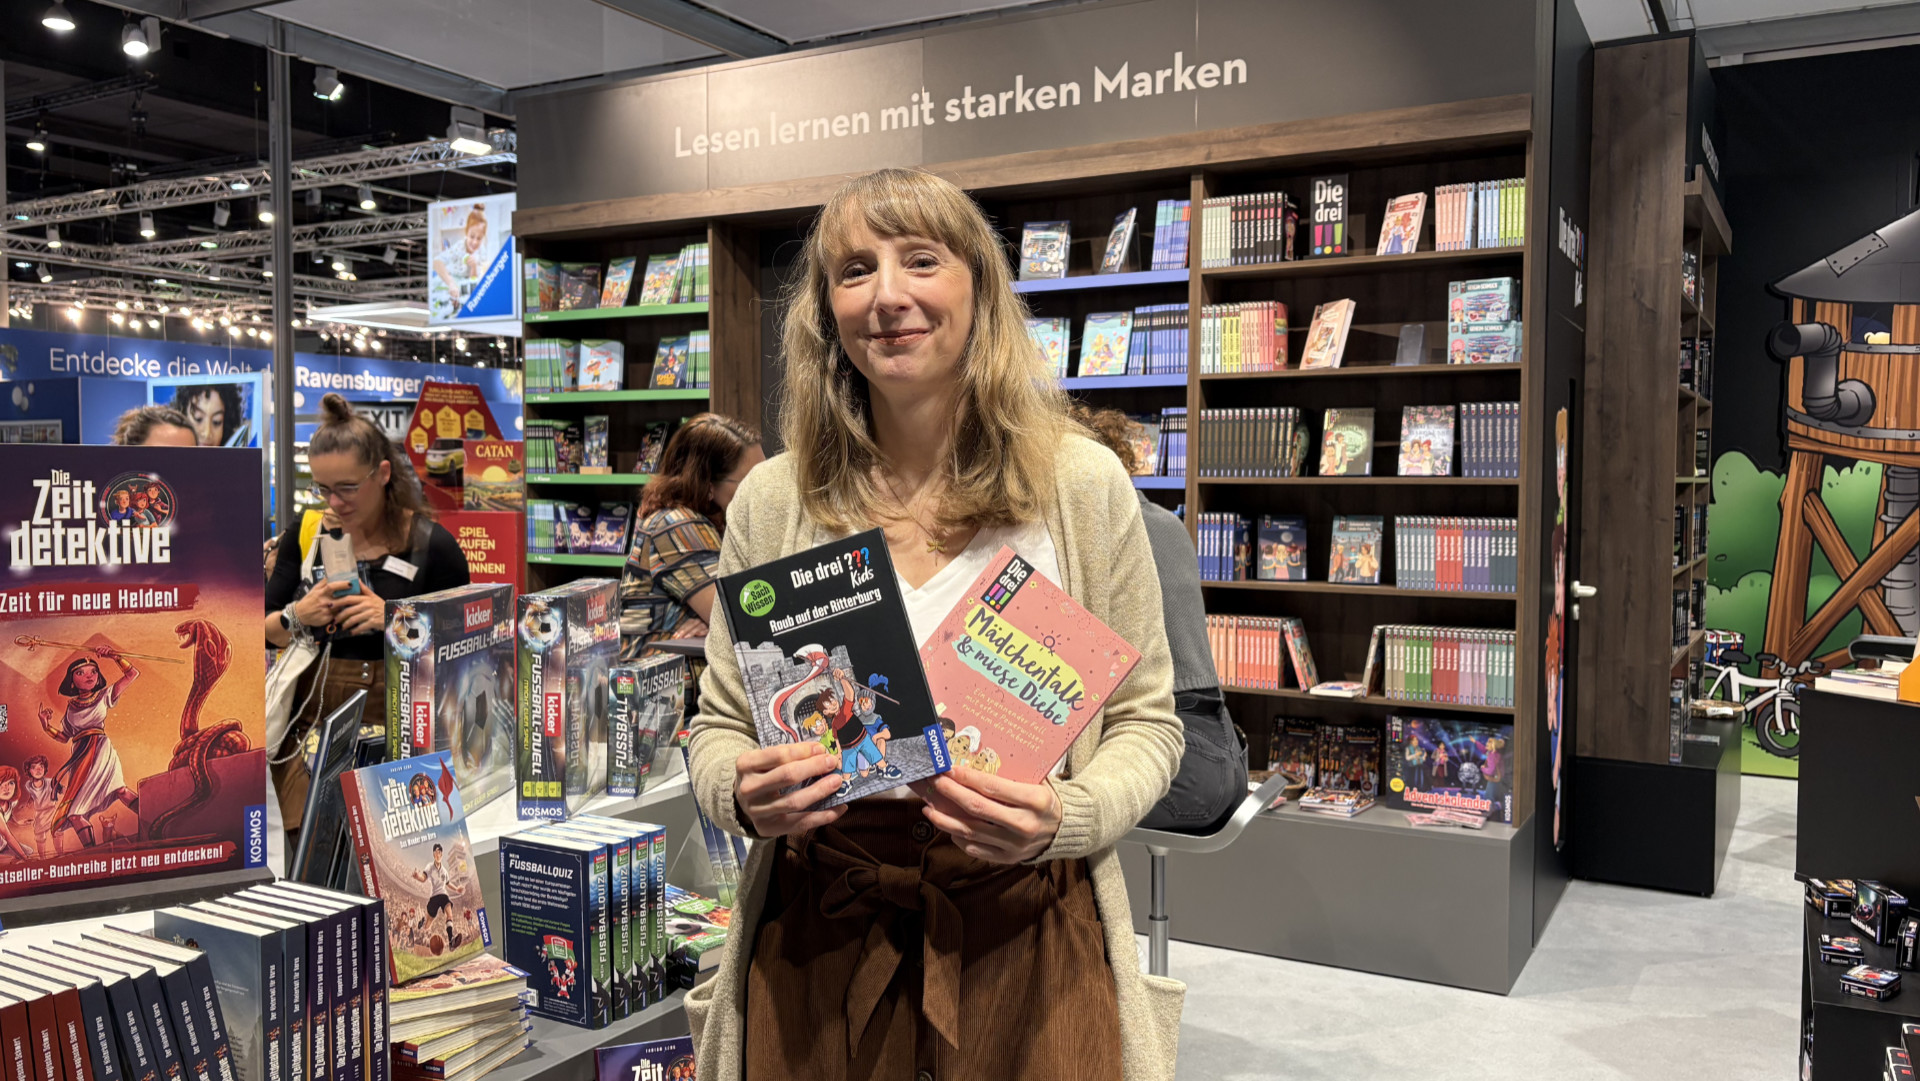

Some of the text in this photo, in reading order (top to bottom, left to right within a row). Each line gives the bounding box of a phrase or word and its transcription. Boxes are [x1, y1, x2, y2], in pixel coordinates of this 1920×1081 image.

[675, 51, 1248, 158] Lesen lernen mit starken Marken
[1315, 179, 1343, 203] Die
[1315, 203, 1342, 222] drei
[467, 250, 511, 313] Ravensburger
[50, 347, 161, 378] Entdecke
[167, 355, 200, 377] die
[295, 366, 421, 397] Ravensburger
[475, 445, 514, 458] CATAN
[51, 469, 70, 486] Die
[32, 479, 97, 525] Zeit
[9, 519, 171, 567] detektive
[459, 527, 489, 538] SPIEL
[469, 562, 506, 574] INNEN!
[791, 568, 813, 588] Die
[815, 556, 843, 582] drei
[851, 567, 874, 588] Kids
[999, 573, 1020, 593] drei
[1006, 559, 1028, 581] Die
[0, 587, 179, 613] Zeit für neue Helden!
[746, 594, 774, 614] Wissen
[751, 585, 770, 600] Sach
[466, 606, 492, 628] kicker
[587, 605, 604, 625] kicker
[769, 588, 882, 633] Raub auf der Ritterburg
[968, 607, 1085, 711] Mädchentalk
[641, 666, 684, 697] FUSSBALL
[957, 637, 1065, 725] & miese Diebe
[416, 705, 427, 745] kicker
[532, 654, 542, 776] FUSSBALL-DUELL
[547, 695, 558, 734] kicker
[974, 688, 1047, 734] Ein spannender Fall
[616, 697, 627, 769] FUSSBALL
[928, 729, 945, 768] KOSMOS
[383, 782, 409, 813] Zeit
[522, 807, 562, 816] KOSMOS
[1404, 786, 1492, 811] Adventskalender
[250, 810, 262, 863] KOSMOS
[381, 802, 441, 842] detektive
[110, 855, 137, 872] jetzt
[141, 854, 160, 868] neu
[164, 845, 223, 865] entdecken!
[509, 859, 574, 879] FUSSBALLQUIZ
[598, 876, 607, 963] FUSSBALLQUIZ
[621, 868, 629, 954] FUSSBALLQUIZ
[478, 911, 489, 943] KOSMOS
[641, 1058, 650, 1068] Die
